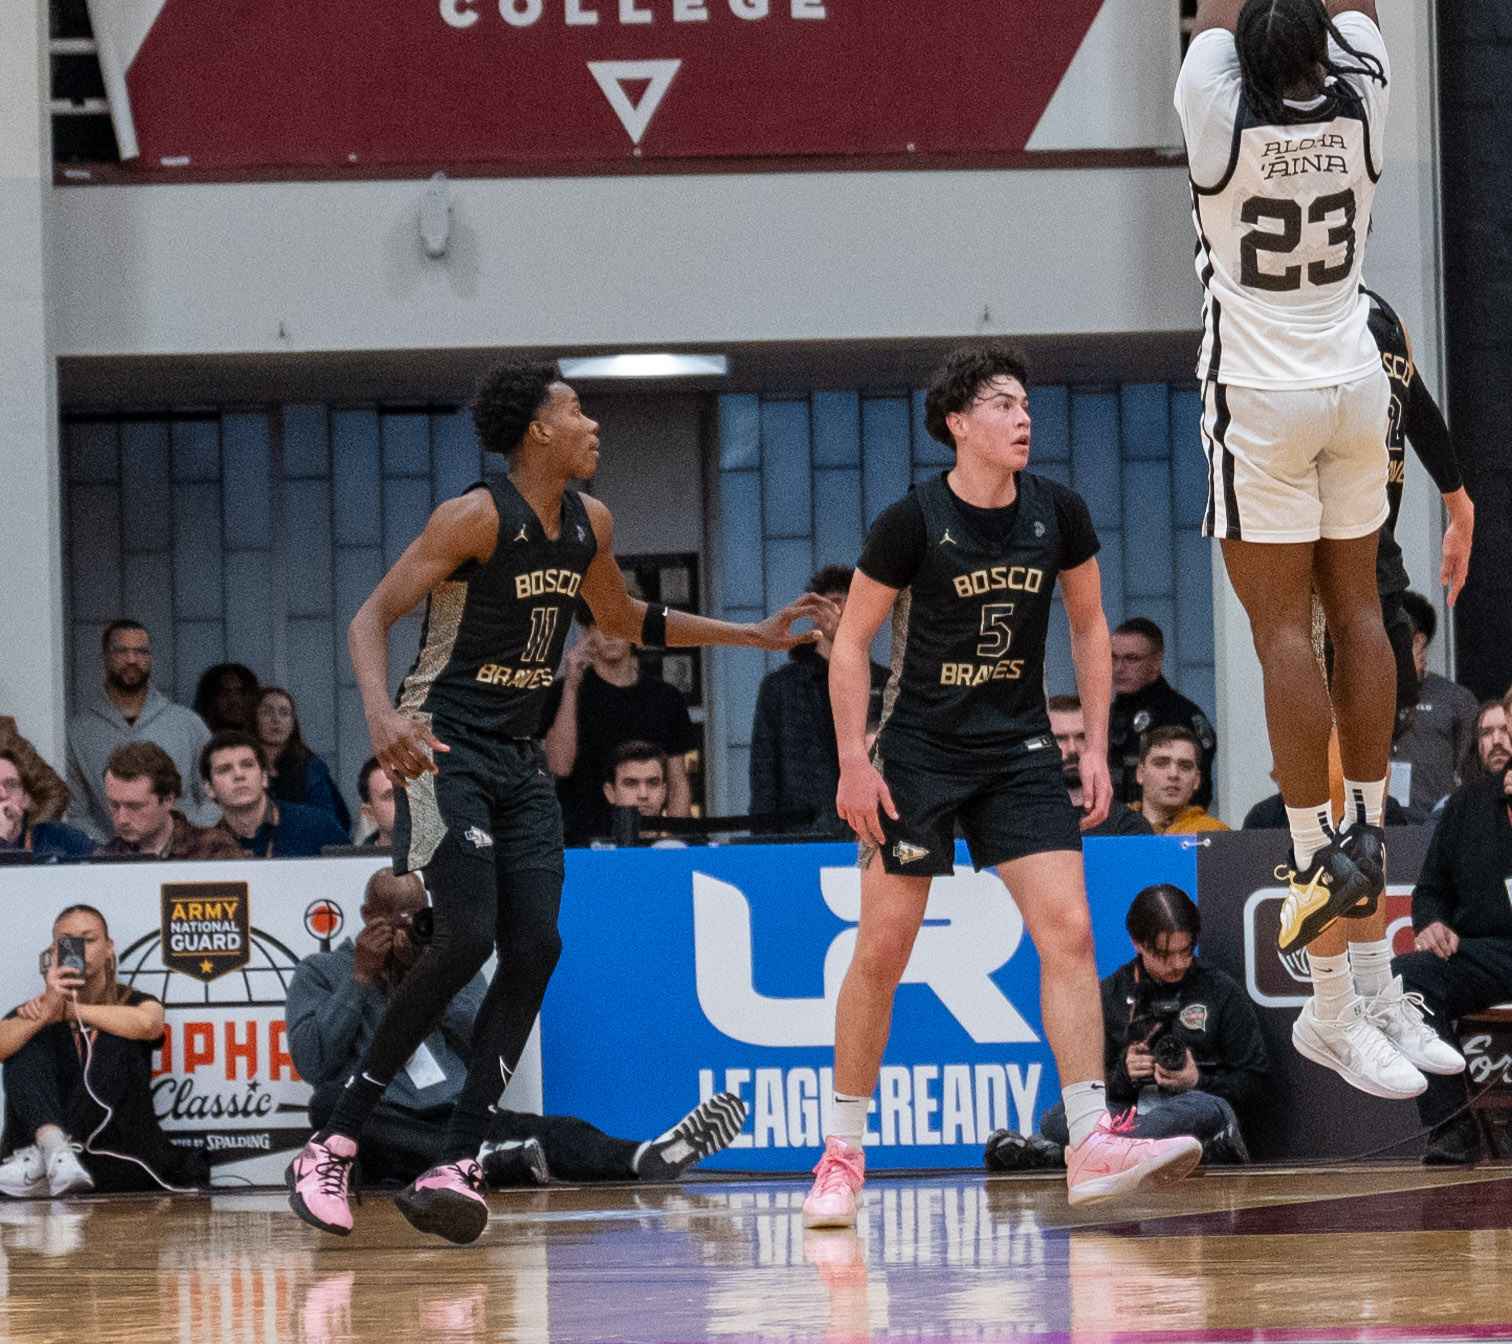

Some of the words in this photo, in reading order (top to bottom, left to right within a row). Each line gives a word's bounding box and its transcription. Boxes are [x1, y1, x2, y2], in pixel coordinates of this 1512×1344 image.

[1240, 188, 1358, 293] 23
[1382, 351, 1413, 388] SCO
[514, 568, 582, 599] BOSCO
[952, 566, 1043, 598] BOSCO
[520, 607, 559, 662] 11
[976, 602, 1015, 658] 5
[170, 920, 240, 934] NATIONAL
[171, 902, 239, 921] ARMY
[170, 932, 241, 951] GUARD
[150, 1076, 272, 1122] Classic
[207, 1133, 271, 1151] SPALDING
